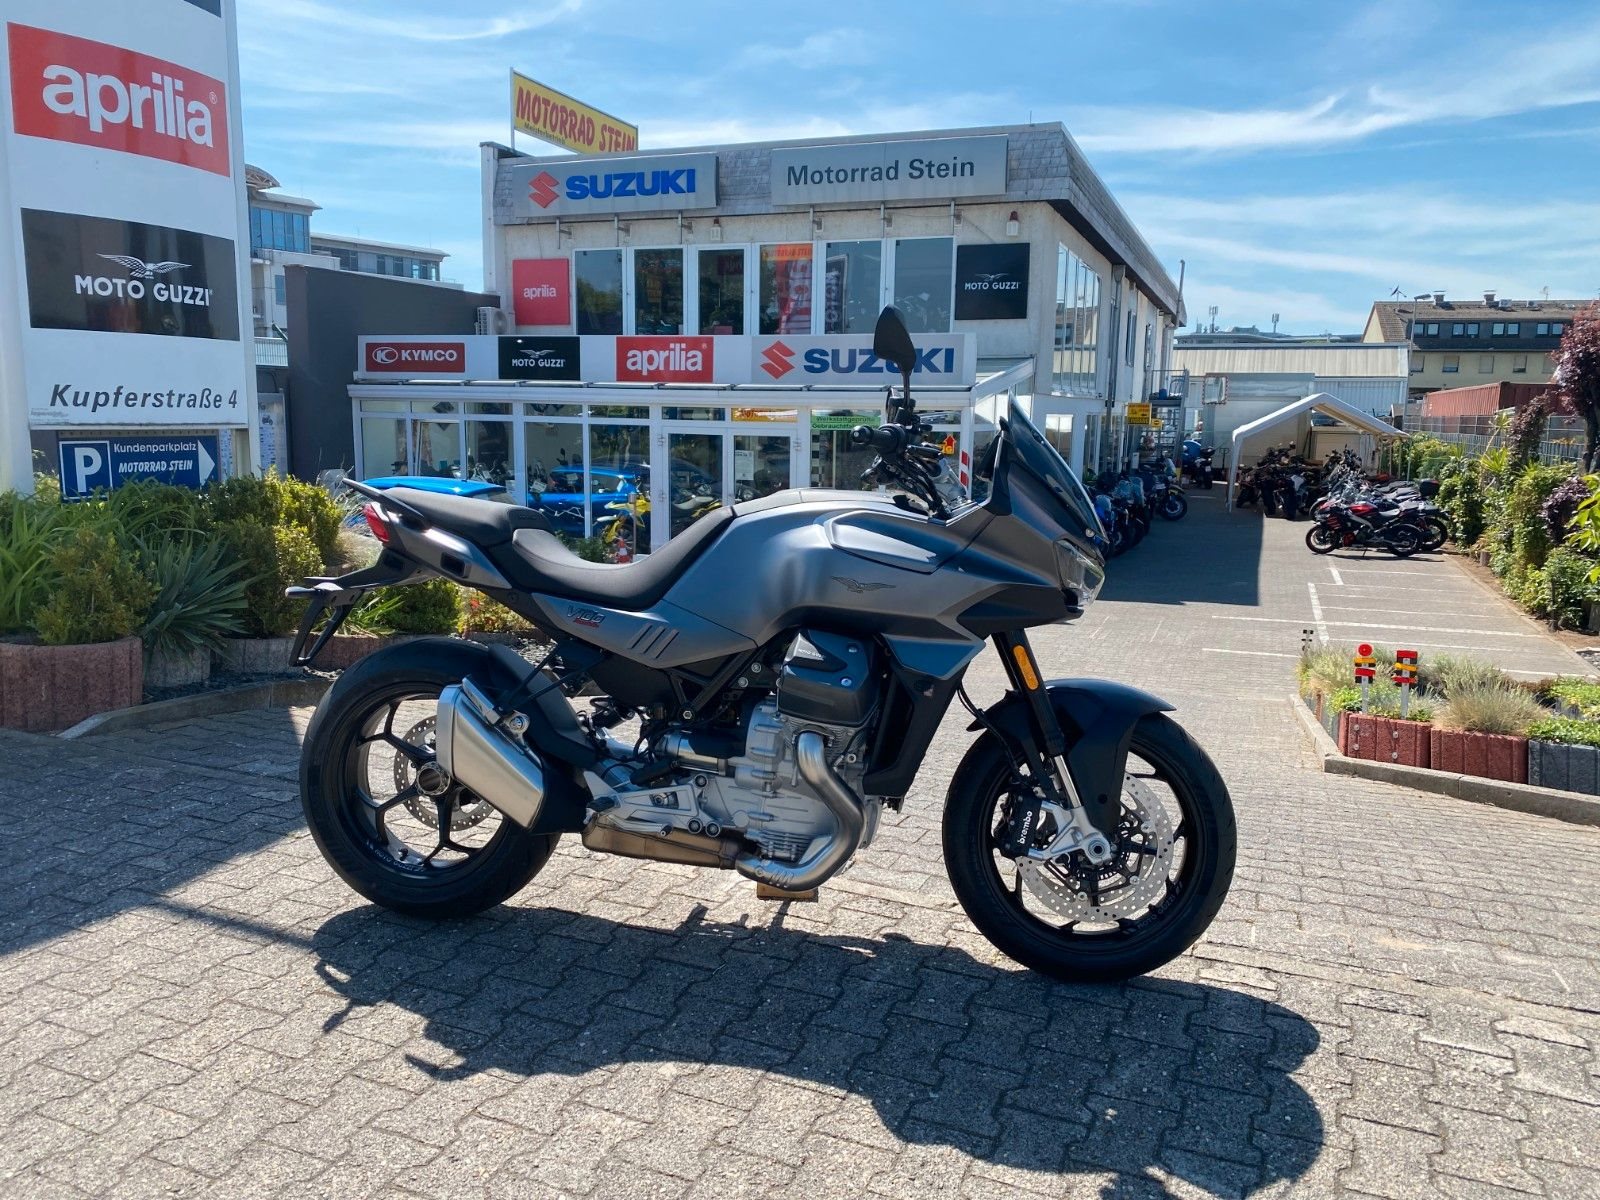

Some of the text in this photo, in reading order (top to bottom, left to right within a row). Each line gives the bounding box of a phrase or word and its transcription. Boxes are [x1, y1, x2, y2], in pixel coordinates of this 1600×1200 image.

[42, 64, 213, 148] aprilia
[516, 86, 635, 152] MOTORRAD STEIN
[565, 168, 696, 200] SUZUKI
[787, 156, 975, 186] Motorrad Stein
[74, 275, 210, 306] MOTO GUZZI
[523, 284, 557, 300] aprilia
[964, 282, 1019, 290] MOTO GUZZI
[401, 349, 458, 361] KYMCO
[511, 358, 564, 368] MOTO GUZZI
[626, 343, 703, 376] aprilia
[50, 384, 238, 412] Kupferstraße 4
[113, 442, 197, 454] Kundenparkplatz
[74, 447, 102, 493] P
[118, 459, 193, 473] MOTORRAD STEIN
[1016, 810, 1033, 844] brembo
